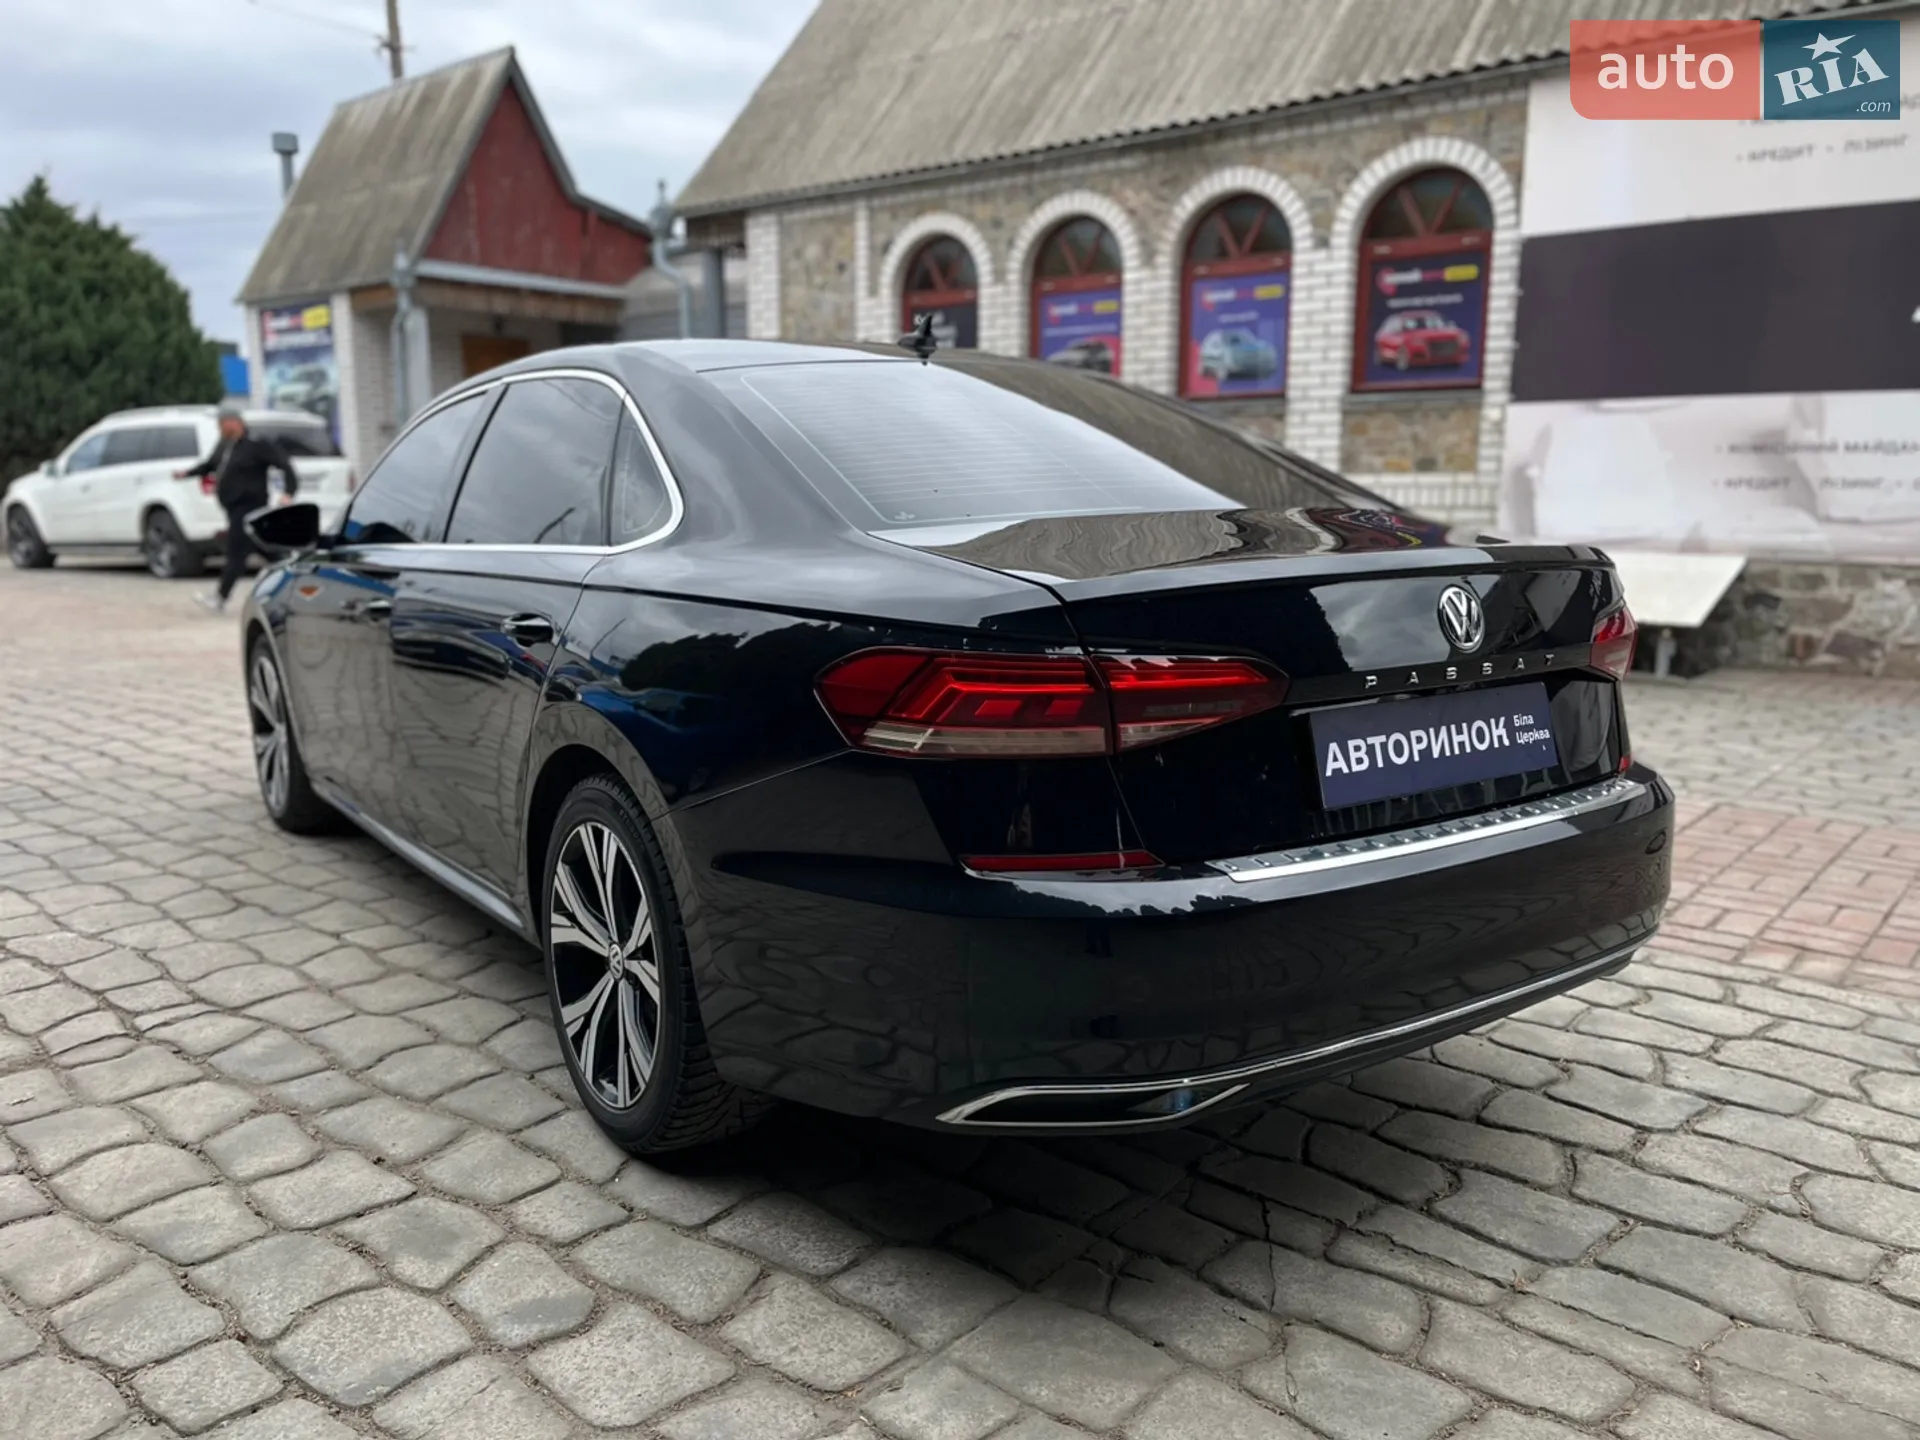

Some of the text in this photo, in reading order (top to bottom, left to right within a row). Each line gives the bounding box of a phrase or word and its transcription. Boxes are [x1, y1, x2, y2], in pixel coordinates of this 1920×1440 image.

[1365, 654, 1555, 689] PASSAT
[1513, 713, 1534, 727] Біла
[1325, 716, 1510, 777] АВТОРИНОК
[1515, 728, 1551, 745] Церква
